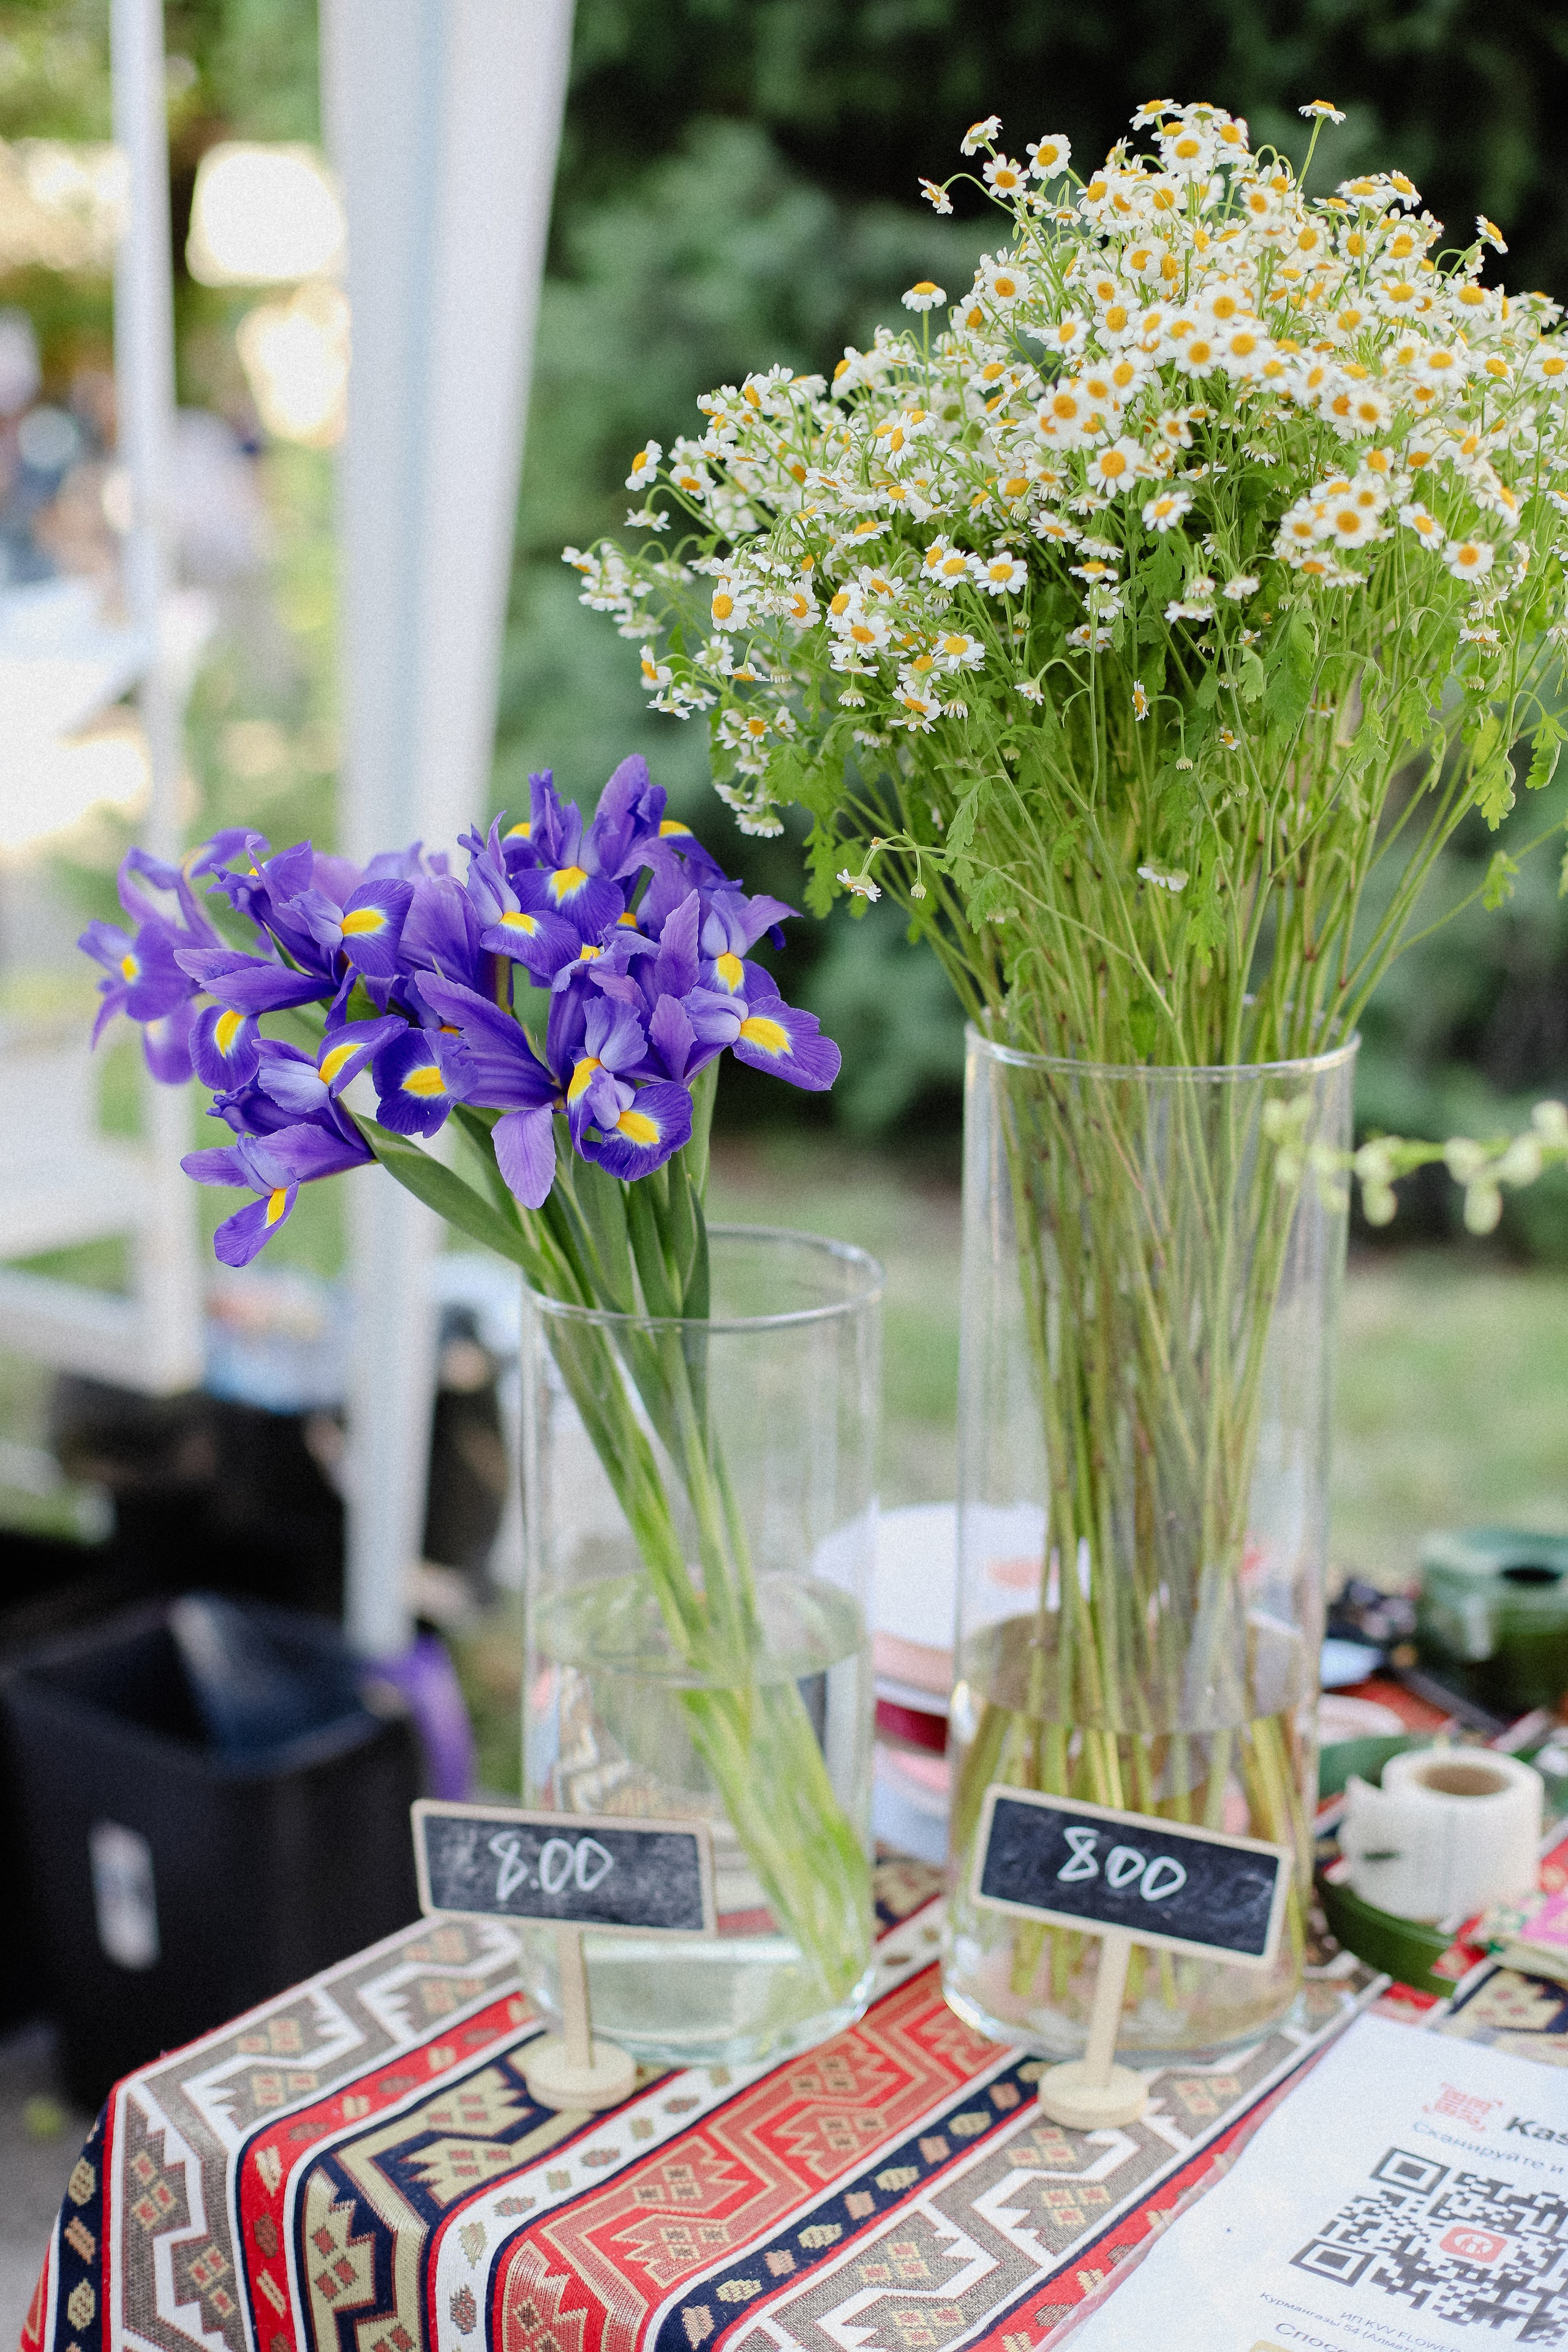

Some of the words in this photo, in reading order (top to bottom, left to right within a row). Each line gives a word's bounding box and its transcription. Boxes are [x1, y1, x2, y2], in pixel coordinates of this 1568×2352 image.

[1057, 1826, 1187, 1901] 800
[1413, 2122, 1544, 2170] Сканируйте
[1550, 2164, 1564, 2174] и
[1260, 2292, 1340, 2327] Курмангазы
[1343, 2324, 1360, 2334] 54
[1340, 2312, 1363, 2324] ИП
[1275, 2323, 1349, 2352] Спос
